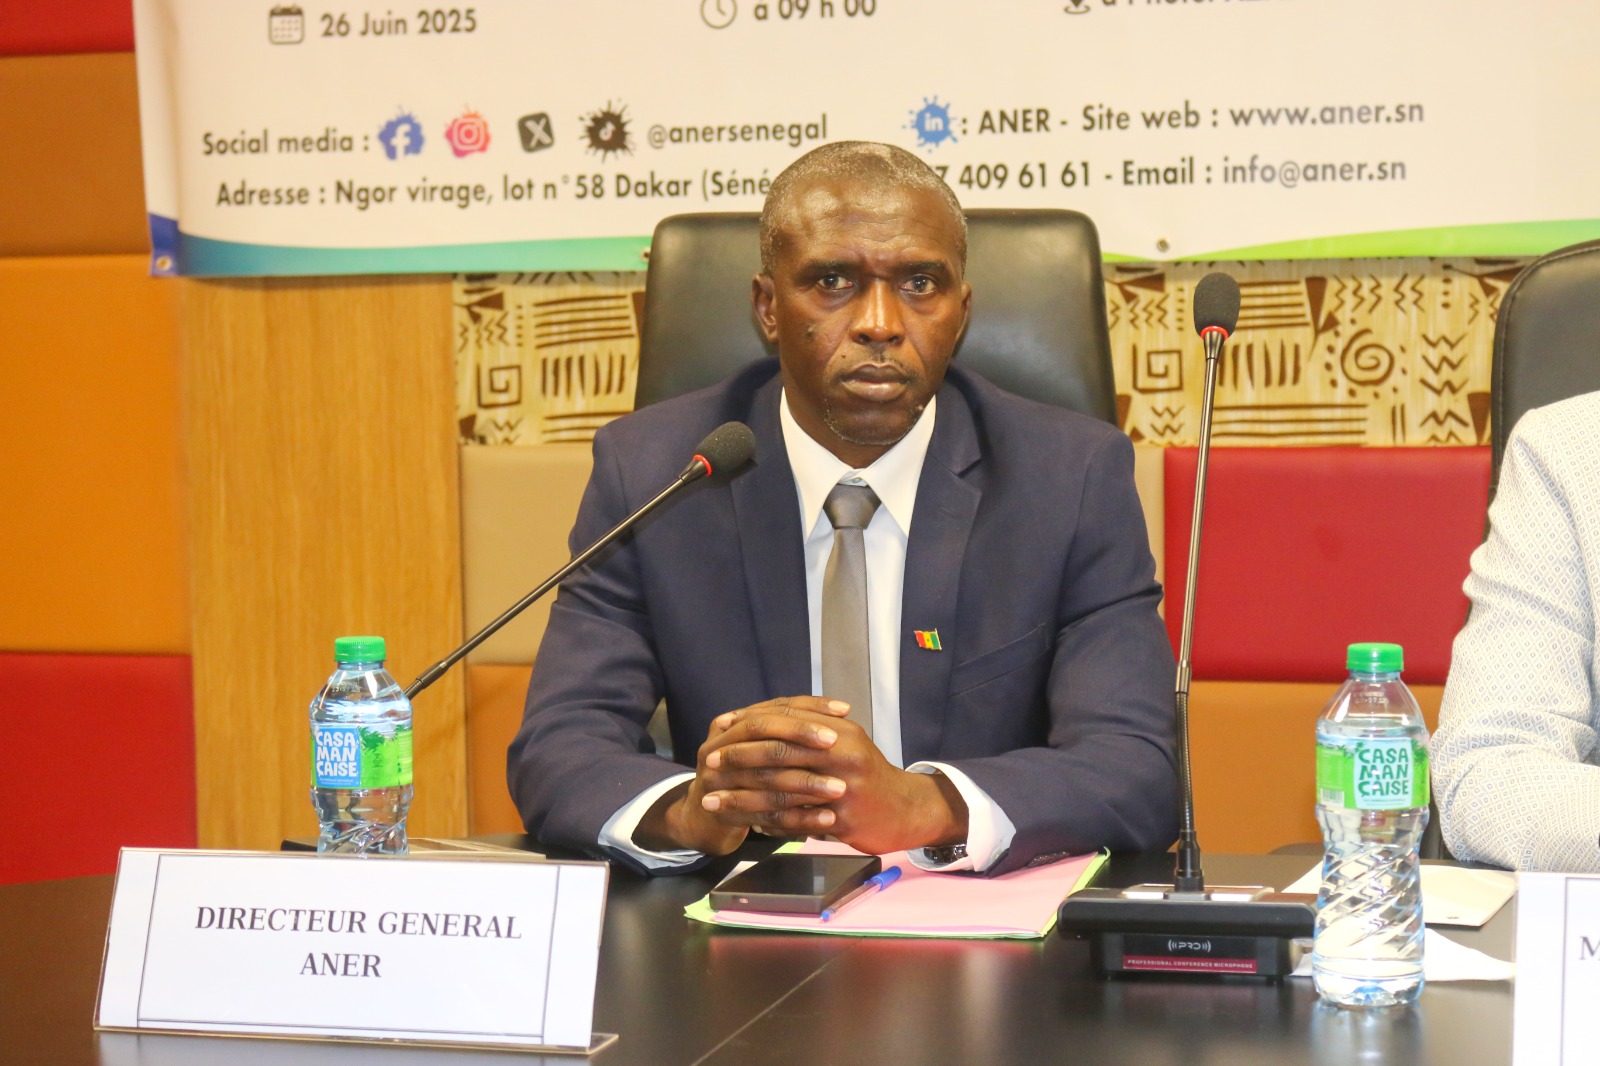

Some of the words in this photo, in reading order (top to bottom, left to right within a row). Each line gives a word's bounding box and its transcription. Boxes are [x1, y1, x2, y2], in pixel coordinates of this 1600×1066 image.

[320, 12, 351, 38] 26
[359, 9, 408, 37] Juin
[416, 8, 477, 35] 2025
[777, 0, 811, 20] 09
[843, 0, 877, 18] 00
[978, 108, 1051, 135] ANER
[1082, 103, 1130, 132] Site
[1141, 99, 1201, 129] web
[1228, 103, 1424, 128] www.aner.sn
[202, 128, 268, 157] Social
[277, 127, 354, 154] media
[648, 113, 828, 149] @anersenegal
[216, 179, 310, 207] Adresse
[335, 179, 398, 211] Ngor
[406, 176, 493, 210] virage,
[503, 174, 535, 201] lot
[615, 170, 692, 199] Dakar
[702, 168, 771, 202] (Séné
[958, 163, 1009, 190] 409
[1018, 162, 1047, 189] 61
[1060, 161, 1089, 188] 61
[1122, 155, 1194, 186] Email
[1223, 153, 1407, 189] info@aner.sn
[315, 731, 356, 747] CASA
[317, 746, 357, 762] MAN
[1358, 747, 1409, 764] CASA
[1359, 763, 1409, 780] MAN
[195, 905, 368, 934] DIRECTEUR
[377, 911, 522, 939] GENERAL
[299, 952, 382, 978] ANER
